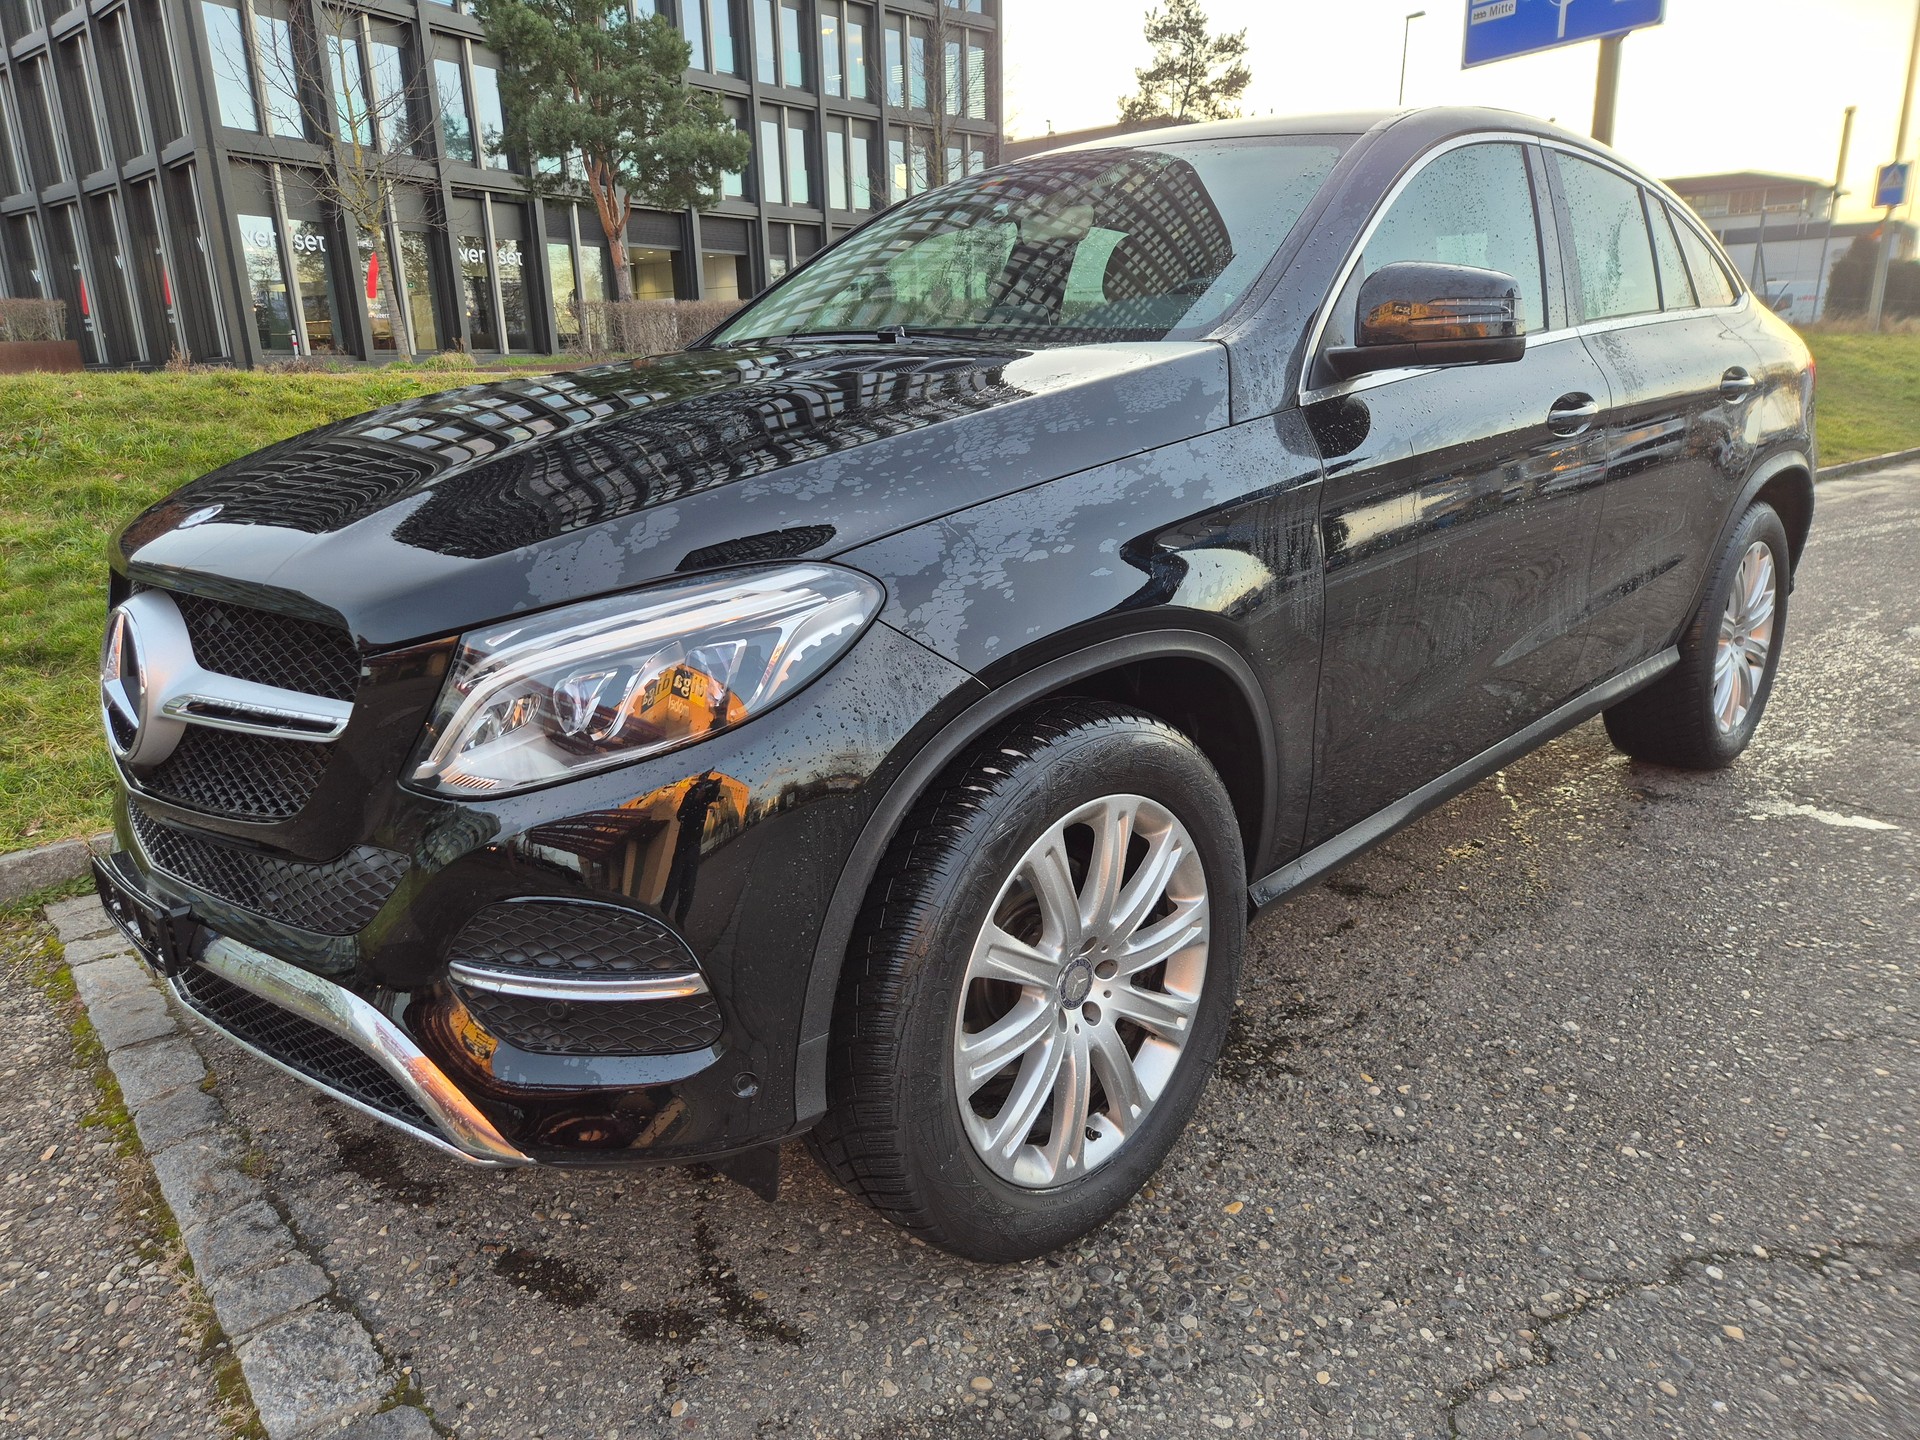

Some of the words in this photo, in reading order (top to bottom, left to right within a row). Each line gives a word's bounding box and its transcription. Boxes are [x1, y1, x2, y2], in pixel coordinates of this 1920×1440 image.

[1490, 3, 1514, 17] Mitte
[294, 233, 327, 253] set
[458, 247, 486, 264] ver
[498, 251, 523, 267] set
